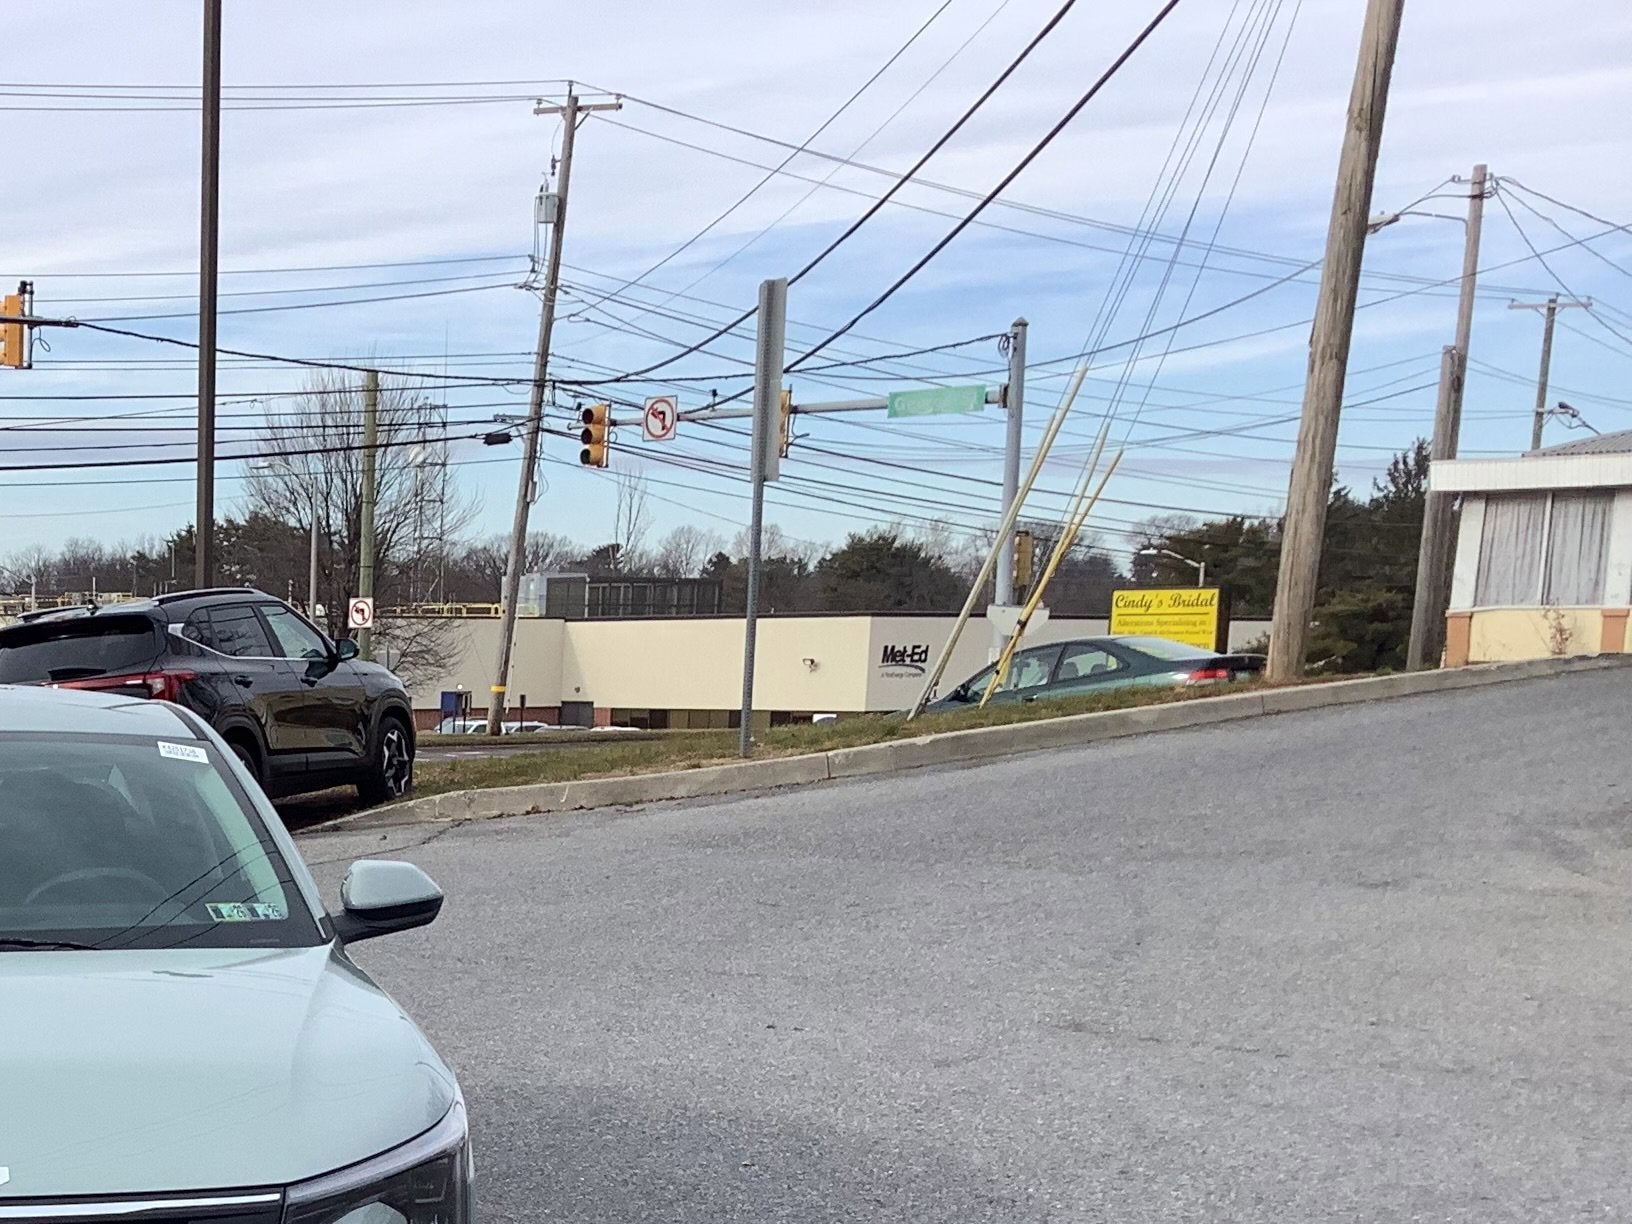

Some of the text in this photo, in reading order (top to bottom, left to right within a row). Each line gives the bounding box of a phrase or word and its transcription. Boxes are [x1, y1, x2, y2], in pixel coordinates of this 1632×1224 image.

[1115, 592, 1216, 613] Cindy's Bridal
[881, 644, 929, 664] Met-Ed
